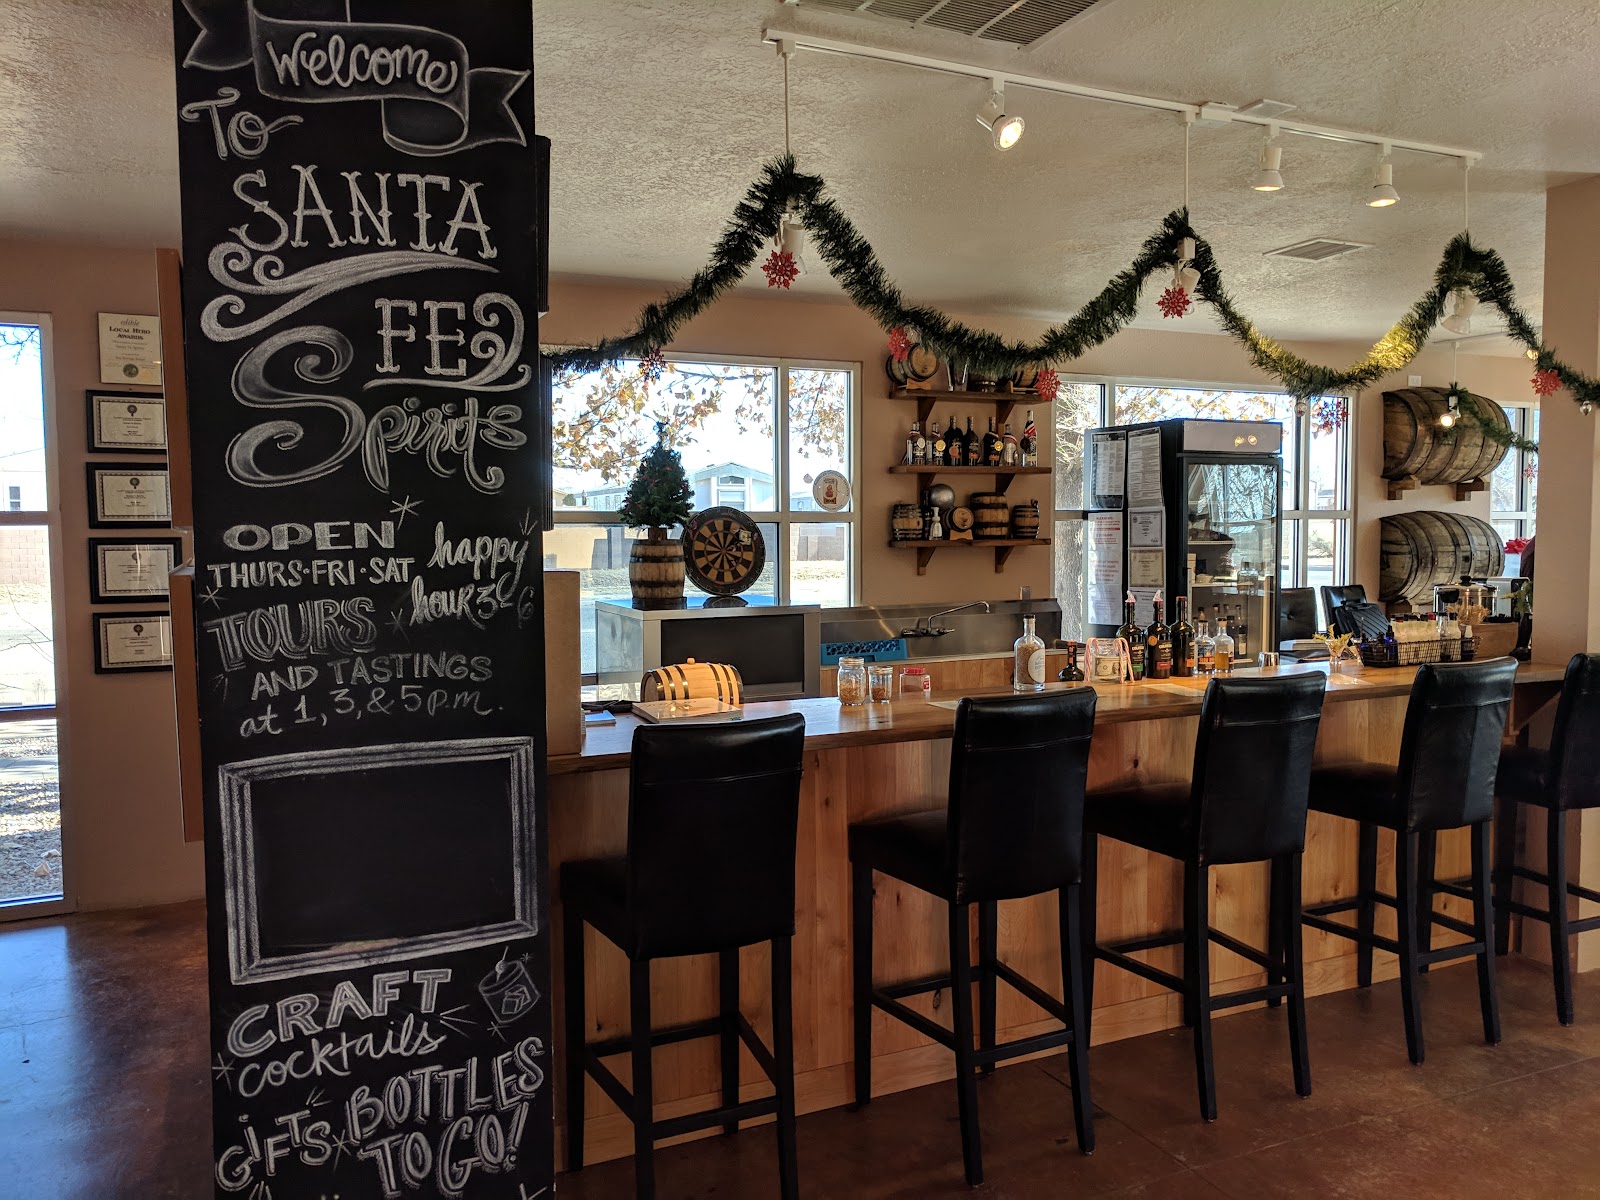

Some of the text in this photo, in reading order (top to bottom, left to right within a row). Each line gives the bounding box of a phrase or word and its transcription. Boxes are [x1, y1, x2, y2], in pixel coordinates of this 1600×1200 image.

[266, 32, 458, 94] Welcome
[228, 164, 498, 260] SANTA
[374, 298, 467, 376] FE
[225, 324, 528, 495] Spirits
[223, 520, 395, 552] OPEN
[427, 521, 529, 601] happy
[203, 596, 378, 673] TOURS
[250, 651, 493, 701] AND TASTINGS
[240, 705, 284, 738] at
[227, 968, 452, 1058] CRAFT
[239, 1013, 448, 1098] cocktails
[347, 1036, 545, 1146] BOTTLES
[356, 1100, 529, 1200] TO GO!
